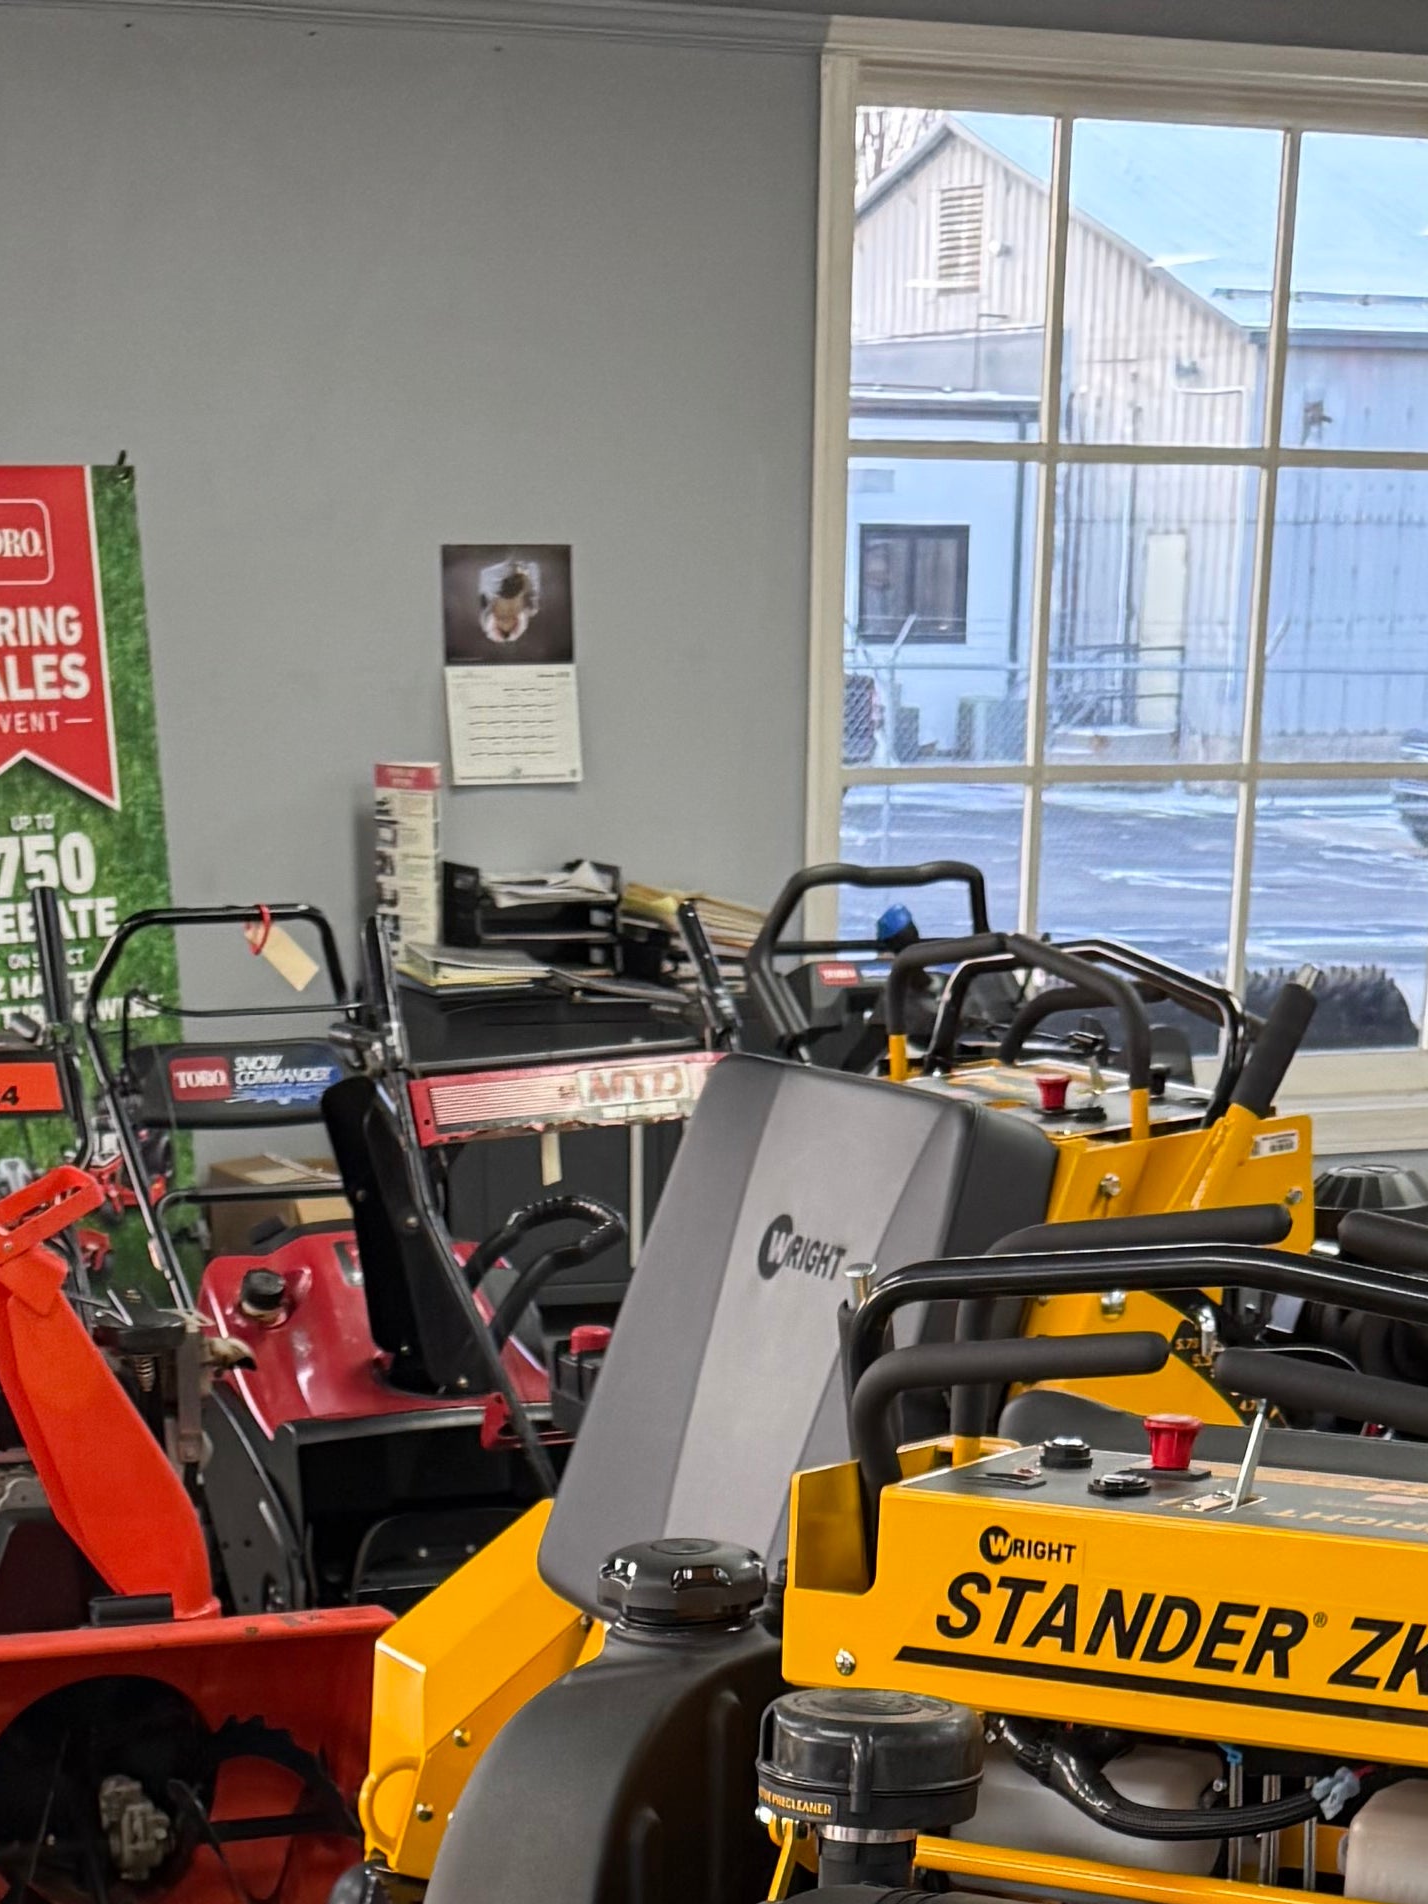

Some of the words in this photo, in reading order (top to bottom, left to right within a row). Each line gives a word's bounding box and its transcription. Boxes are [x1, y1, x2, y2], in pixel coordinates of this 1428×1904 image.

[11, 815, 32, 832] UP
[35, 814, 55, 830] TO
[234, 1055, 283, 1071] SNOW
[174, 1069, 226, 1089] TORO
[235, 1066, 333, 1085] COMMANDER
[758, 1214, 847, 1280] WRIGHT
[979, 1525, 1076, 1564] WRIGHT
